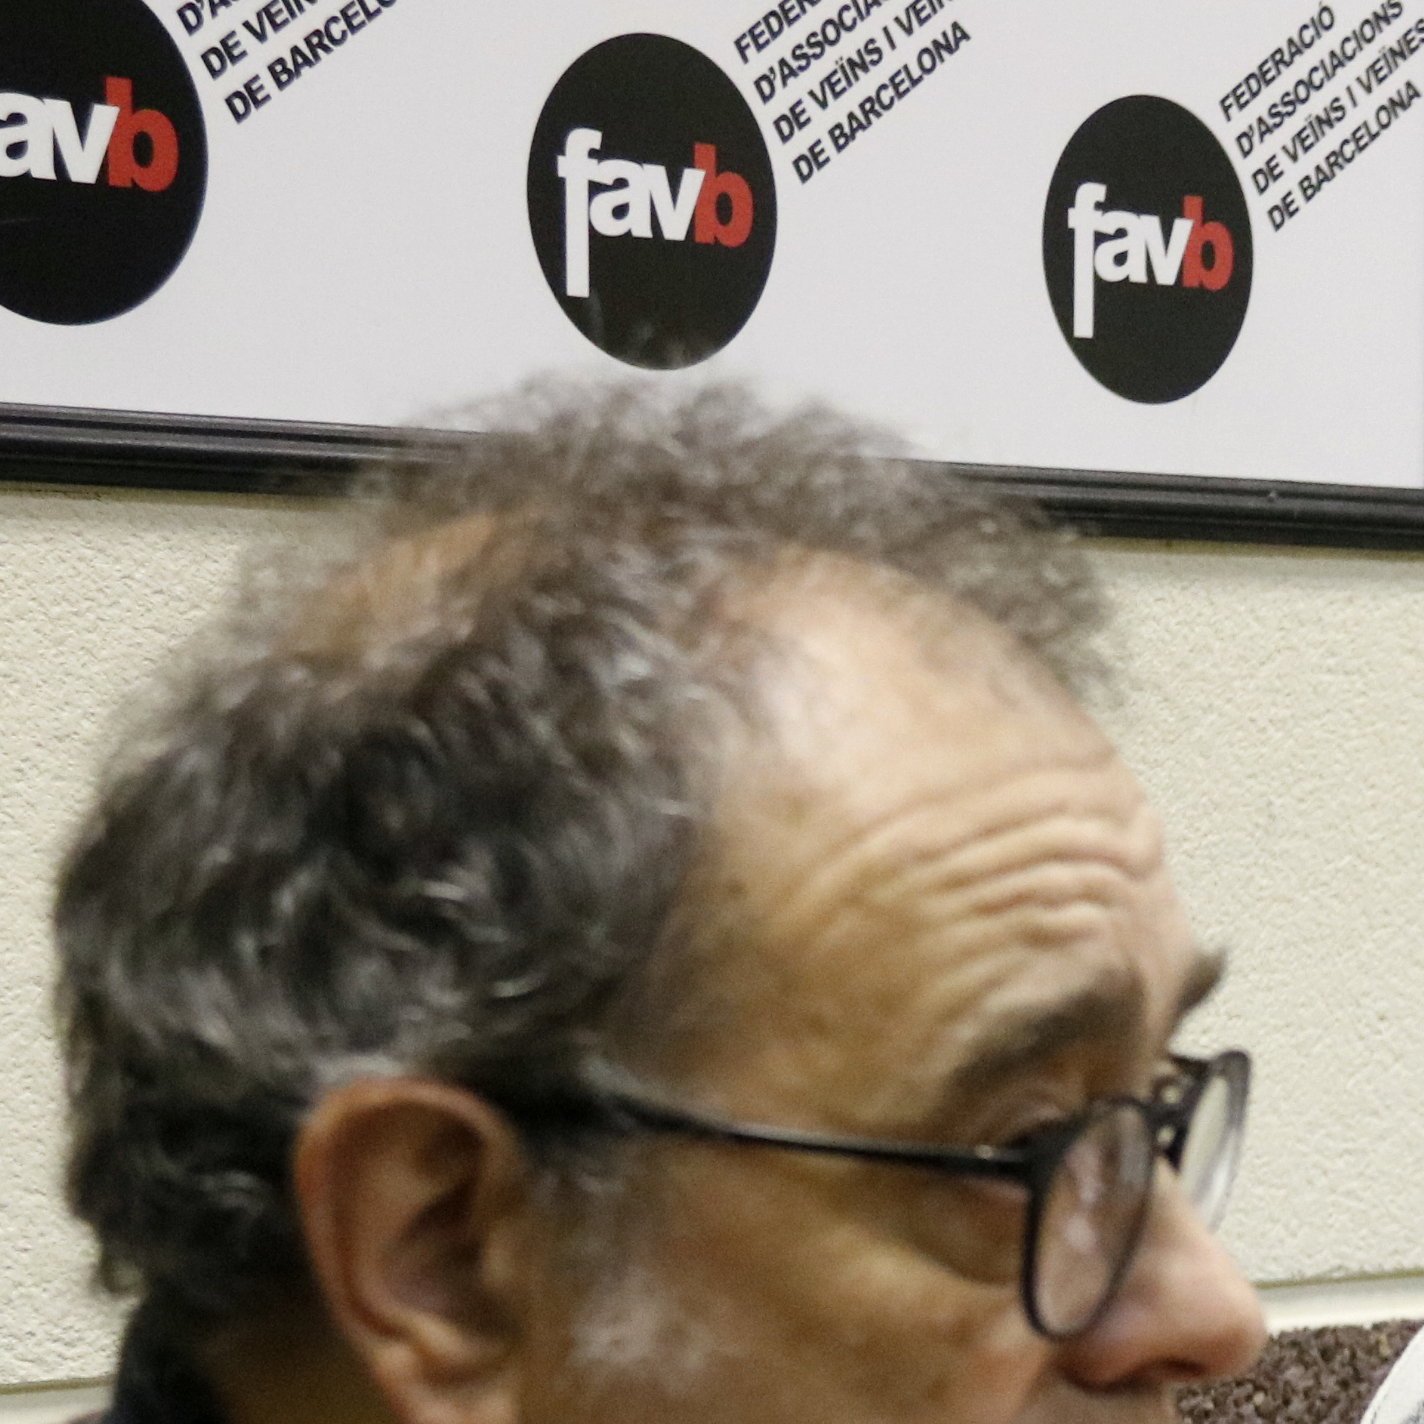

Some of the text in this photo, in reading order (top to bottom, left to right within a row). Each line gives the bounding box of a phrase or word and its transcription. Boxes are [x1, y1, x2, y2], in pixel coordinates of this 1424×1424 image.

[201, 31, 248, 80] DE
[225, 0, 397, 124] DE BARCEL
[773, 98, 811, 144] DE
[808, 38, 884, 110] VEÏNS
[882, 26, 897, 51] I
[792, 21, 971, 184] DE BARCELONA
[1219, 0, 1335, 122] FEDERACIÓ
[1235, 0, 1403, 159] D'ASSOCIACIONS
[1252, 154, 1284, 196] DE
[1282, 96, 1347, 164] VEÏNS
[1345, 85, 1358, 108] I
[1267, 80, 1422, 232] DE BARCELONA
[557, 128, 754, 297] favb
[1067, 182, 1234, 338] favb
